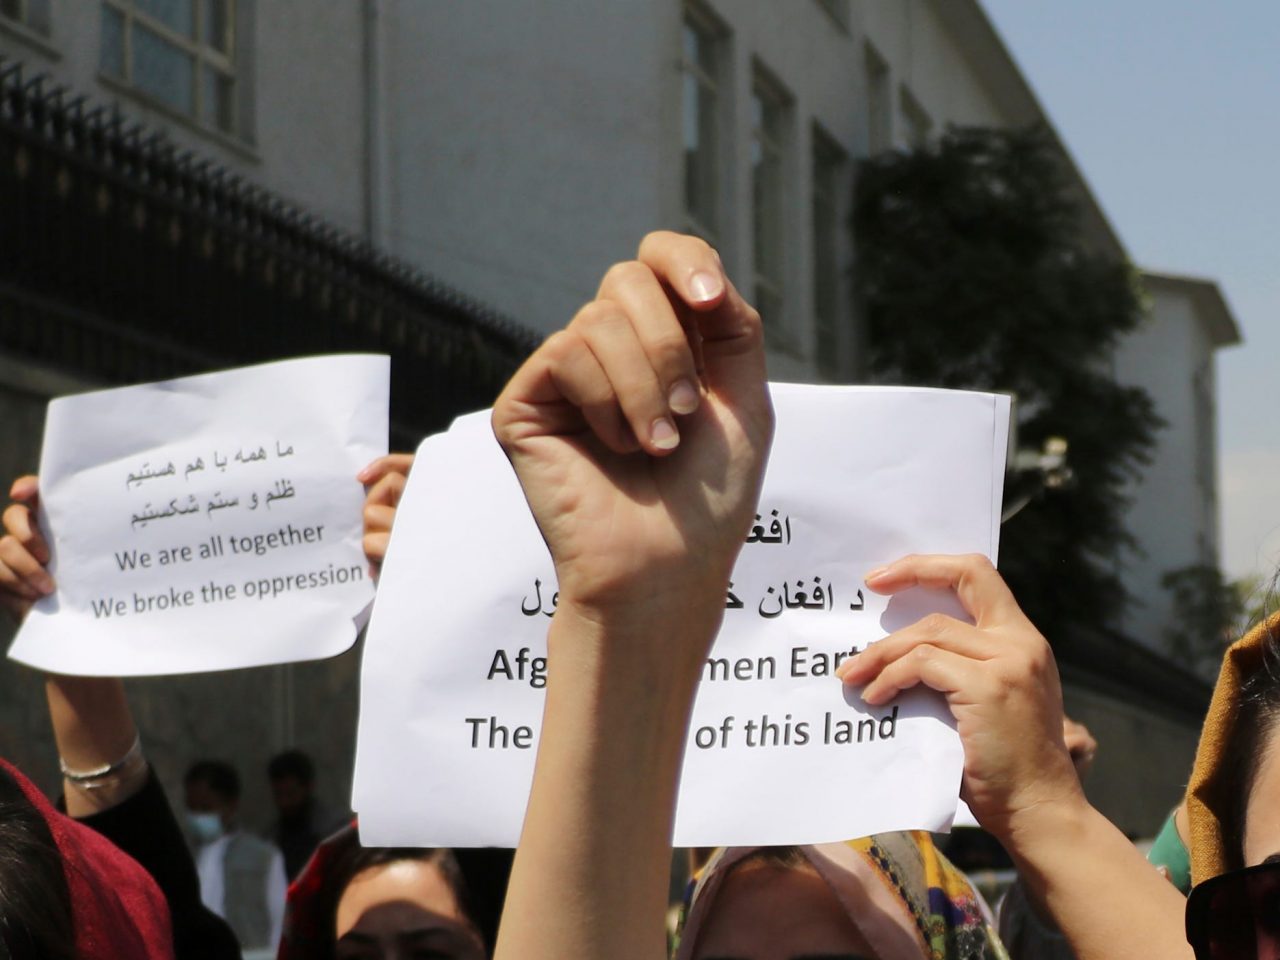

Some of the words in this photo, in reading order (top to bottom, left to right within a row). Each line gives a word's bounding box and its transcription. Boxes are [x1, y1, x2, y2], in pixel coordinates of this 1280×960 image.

[235, 447, 266, 463] همه
[276, 441, 293, 457] ما
[184, 457, 205, 481] هم
[215, 452, 227, 472] با
[126, 461, 176, 490] هستیم
[207, 493, 239, 514] ستم
[249, 493, 258, 510] و
[266, 479, 295, 504] ظلم
[130, 494, 200, 531] شکستیم
[115, 550, 150, 571] We
[159, 546, 191, 565] are
[199, 535, 223, 559] all
[229, 524, 324, 555] together
[91, 598, 126, 619] We
[133, 587, 193, 613] broke
[201, 581, 235, 603] the
[243, 563, 363, 598] oppression
[758, 576, 833, 618] افغان
[850, 589, 864, 611] د
[487, 647, 549, 688] Afg
[702, 656, 776, 681] men
[790, 646, 861, 678] Ear
[465, 716, 532, 749] The
[695, 714, 734, 750] of
[744, 714, 809, 747] this
[824, 704, 898, 744] land
